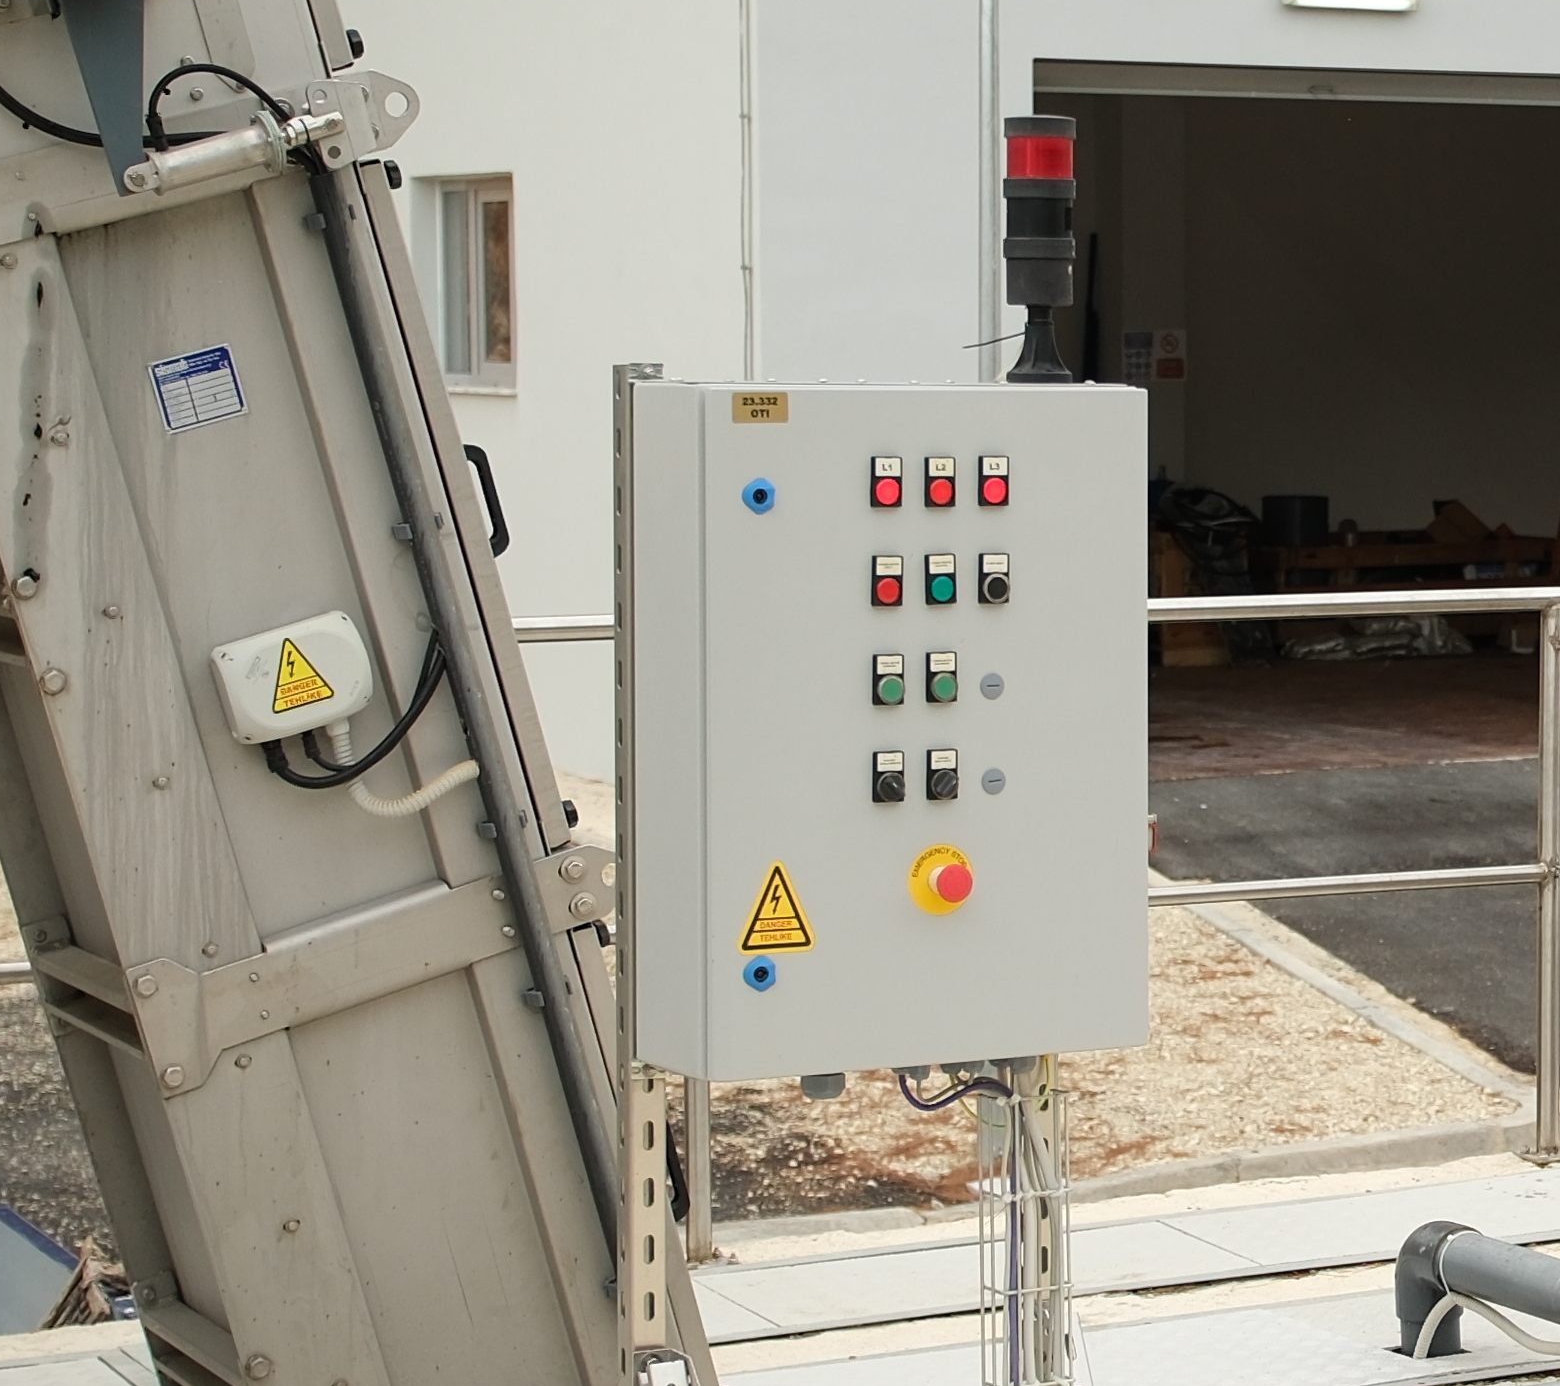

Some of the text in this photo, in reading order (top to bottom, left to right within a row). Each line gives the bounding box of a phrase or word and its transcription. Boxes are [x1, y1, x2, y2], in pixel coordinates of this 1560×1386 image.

[750, 409, 770, 418] OTI
[881, 463, 893, 471] L1
[935, 463, 947, 471] L2
[989, 462, 1000, 471] L3
[280, 679, 319, 695] DANGER
[911, 846, 951, 878] EMERGENCY
[760, 920, 793, 929] DANGER
